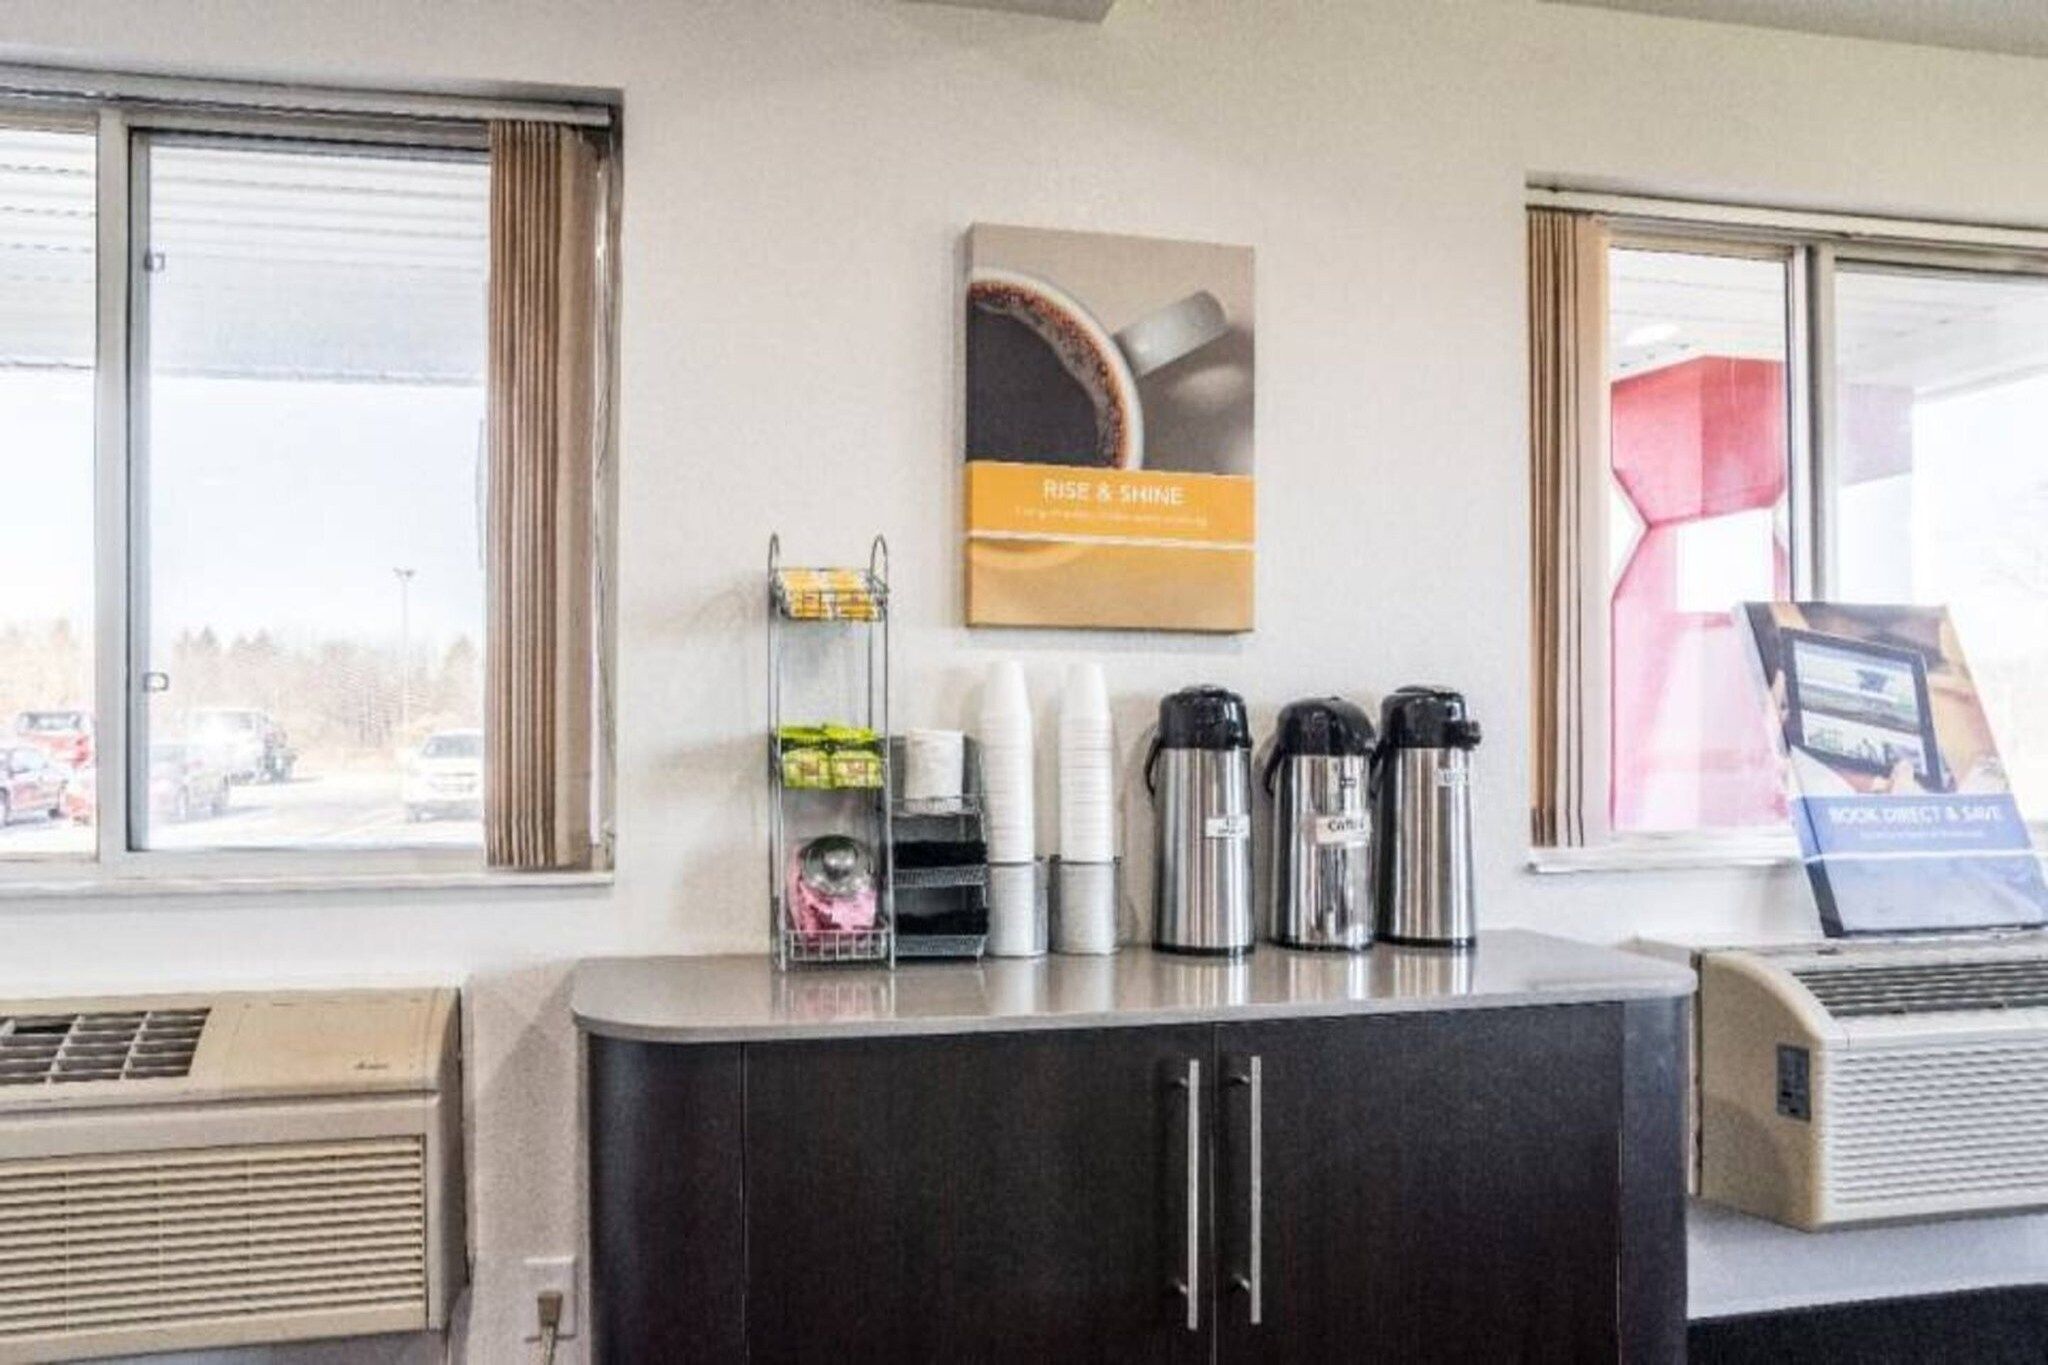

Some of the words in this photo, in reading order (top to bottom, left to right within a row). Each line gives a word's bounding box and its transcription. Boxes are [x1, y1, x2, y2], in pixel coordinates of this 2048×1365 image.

[1043, 479, 1089, 501] RISE
[1096, 481, 1111, 502] &
[1121, 484, 1185, 505] SHINE
[1829, 807, 1880, 823] BOOK
[1882, 806, 1940, 822] DIRECT
[1944, 806, 1958, 821] &
[1961, 805, 2003, 821] SAVE
